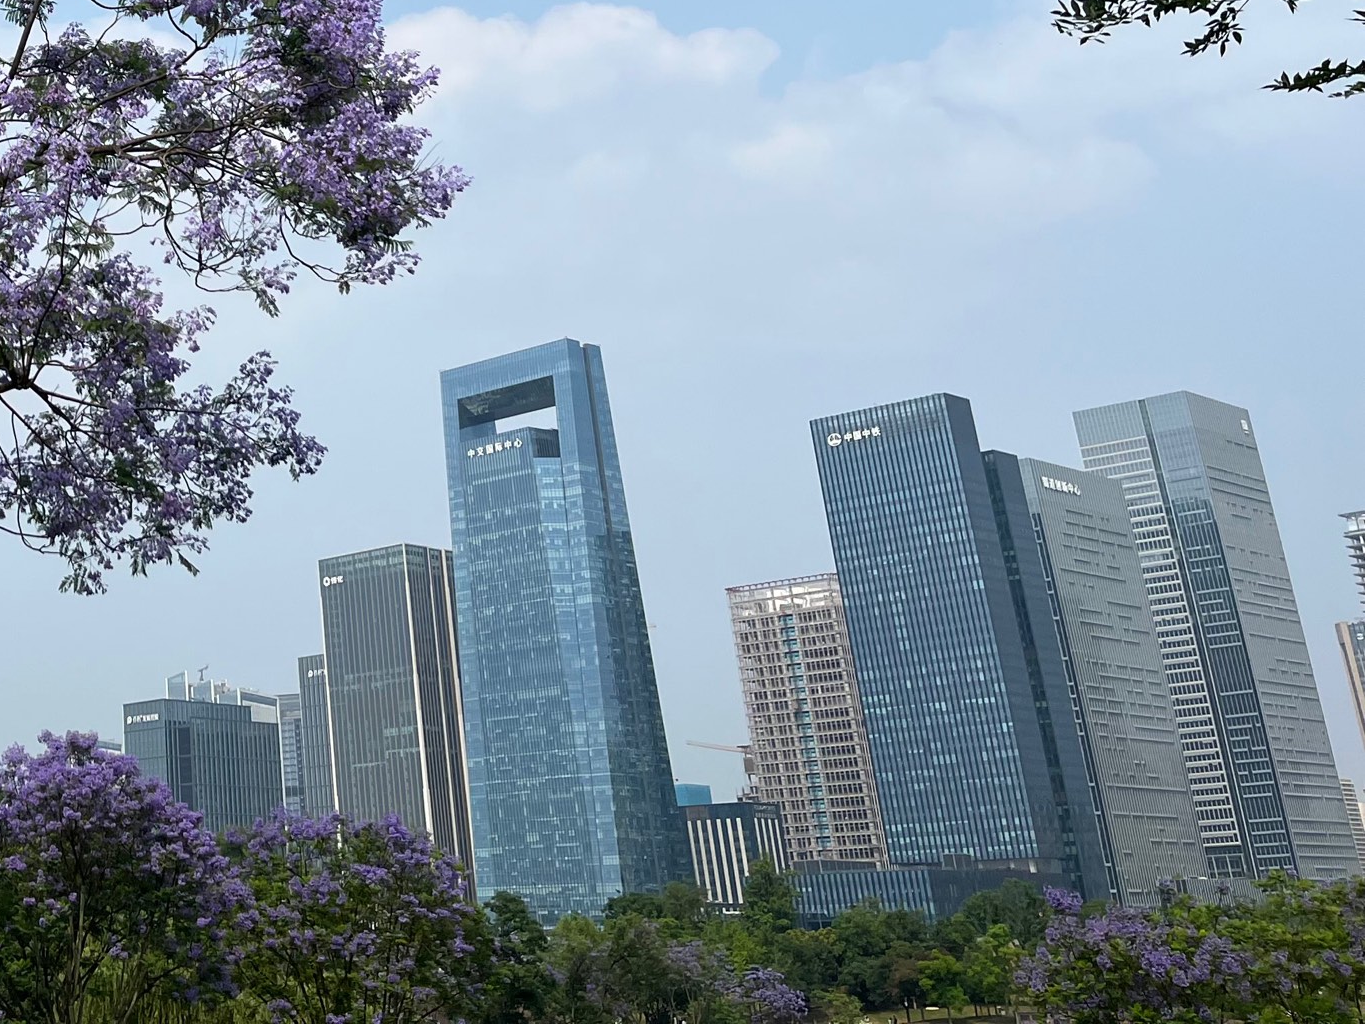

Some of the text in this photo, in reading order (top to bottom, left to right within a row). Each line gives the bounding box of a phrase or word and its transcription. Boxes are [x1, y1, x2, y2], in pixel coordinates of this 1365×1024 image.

[843, 425, 881, 442] 中国中铁
[467, 437, 523, 458] 中交国际中心
